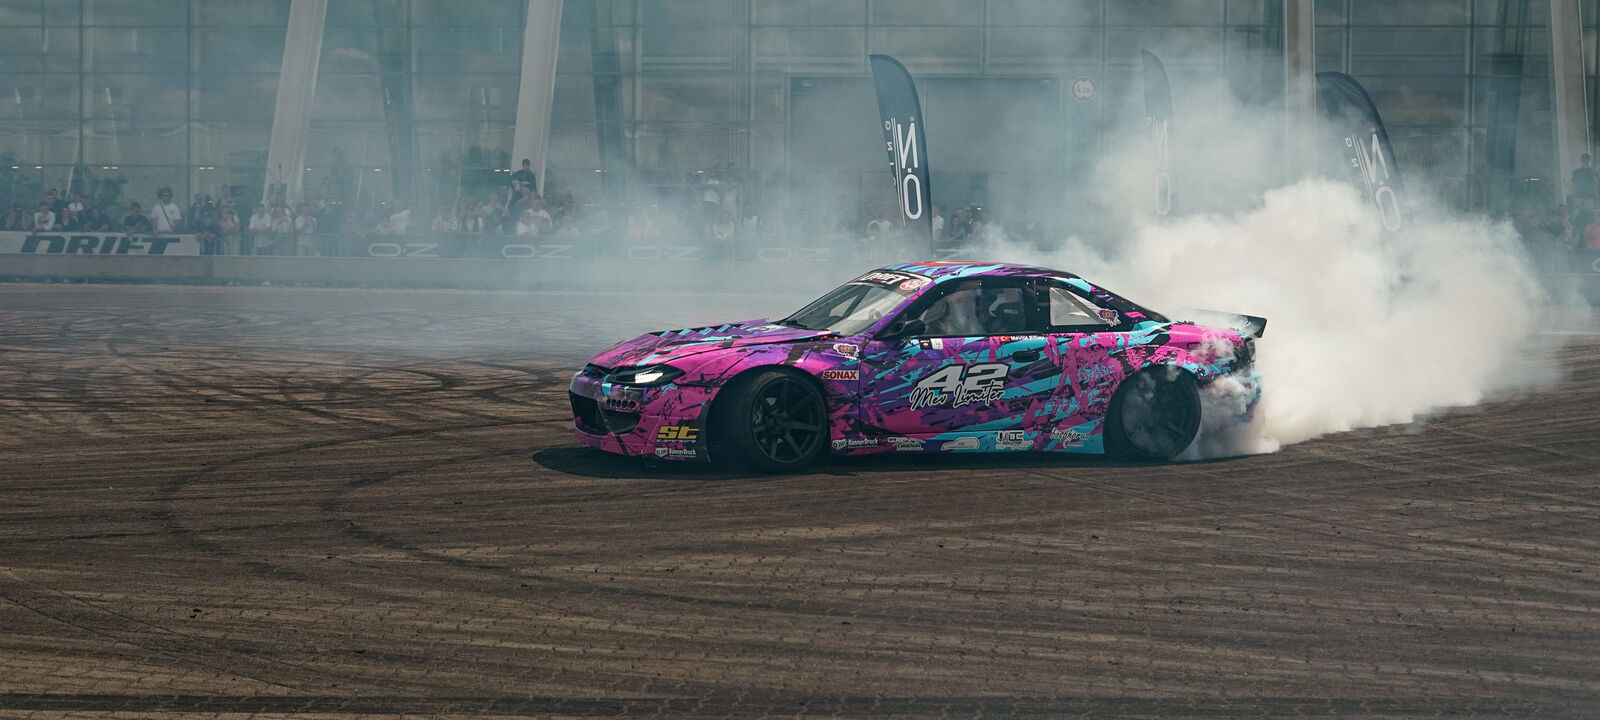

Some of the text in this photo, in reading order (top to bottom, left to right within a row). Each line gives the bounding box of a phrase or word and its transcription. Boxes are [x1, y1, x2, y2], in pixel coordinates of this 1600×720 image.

[21, 235, 180, 255] DRIFT
[822, 370, 857, 380] SONAX
[917, 363, 1010, 392] 42
[910, 380, 1005, 411] Mev Limiter
